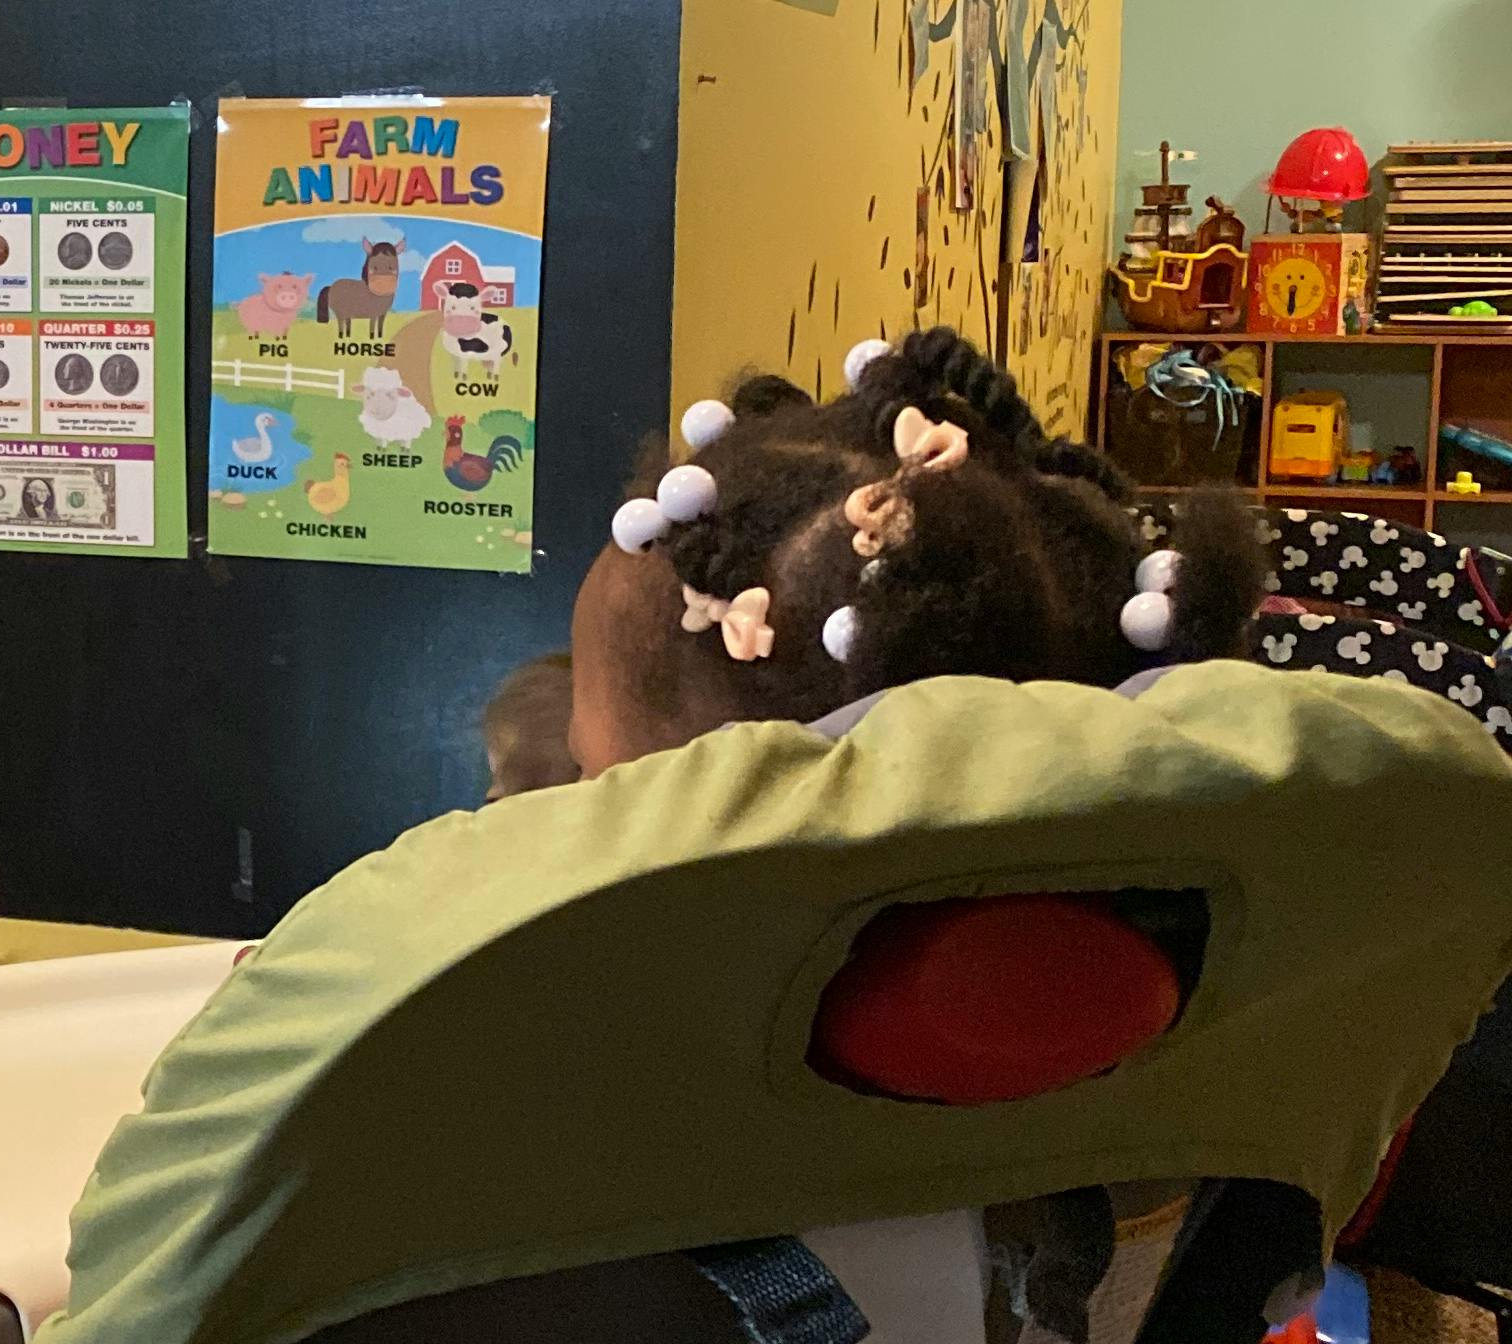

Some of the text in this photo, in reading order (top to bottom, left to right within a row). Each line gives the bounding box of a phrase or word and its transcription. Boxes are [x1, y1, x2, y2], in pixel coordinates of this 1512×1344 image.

[309, 115, 460, 159] FARM
[263, 164, 504, 206] ANIMALS
[50, 201, 99, 212] NICKEL
[67, 219, 128, 228] FIVE CENTS
[44, 324, 150, 335] QUARTER $0.25
[116, 342, 150, 350] CENTS
[259, 344, 288, 357] PIG
[333, 342, 396, 356] HORSE
[455, 383, 499, 396] COW
[42, 445, 69, 456] BILL
[82, 446, 118, 458] $1.00
[363, 453, 423, 468] SHEEP
[227, 465, 277, 480] DUCK
[424, 501, 513, 517] ROOSTER
[286, 523, 366, 539] CHICKEN
